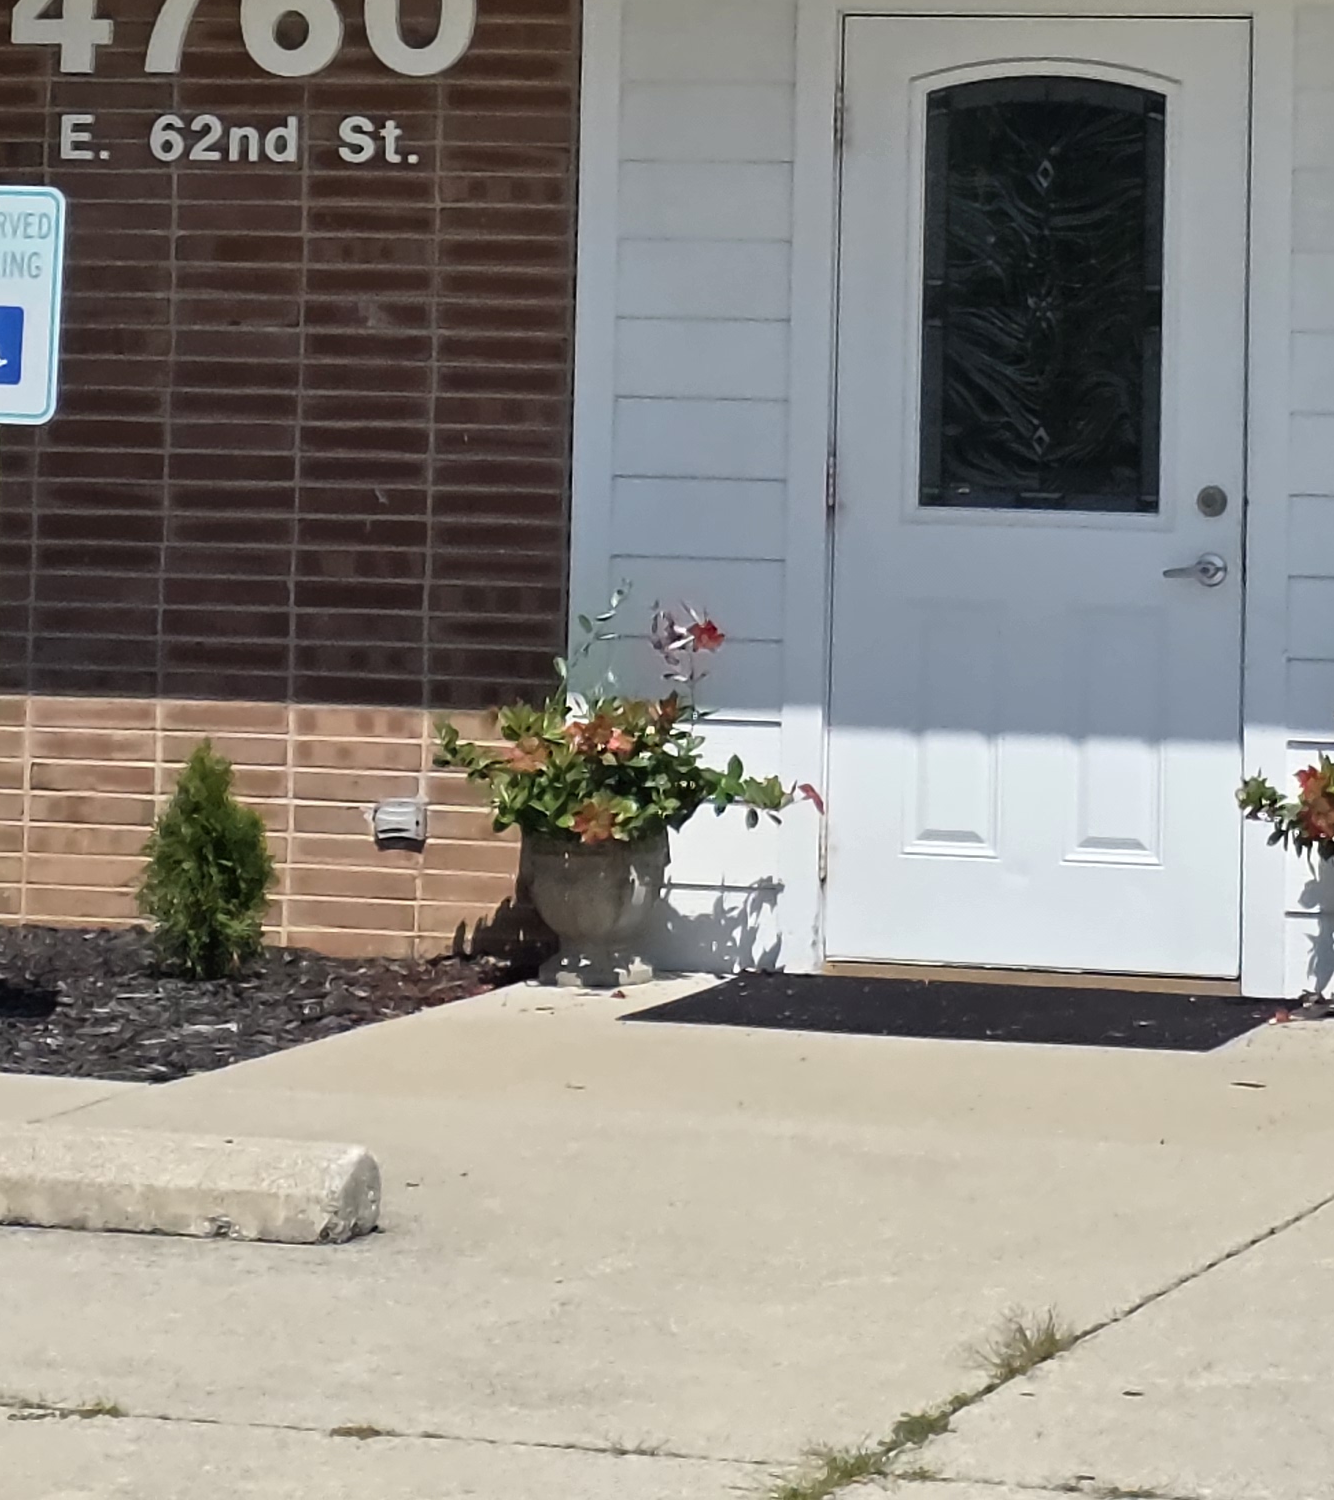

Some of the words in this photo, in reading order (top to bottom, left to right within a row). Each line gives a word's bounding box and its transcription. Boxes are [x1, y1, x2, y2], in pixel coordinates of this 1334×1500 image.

[60, 114, 110, 160] E.
[149, 114, 300, 162] 62nd
[338, 116, 420, 164] St.
